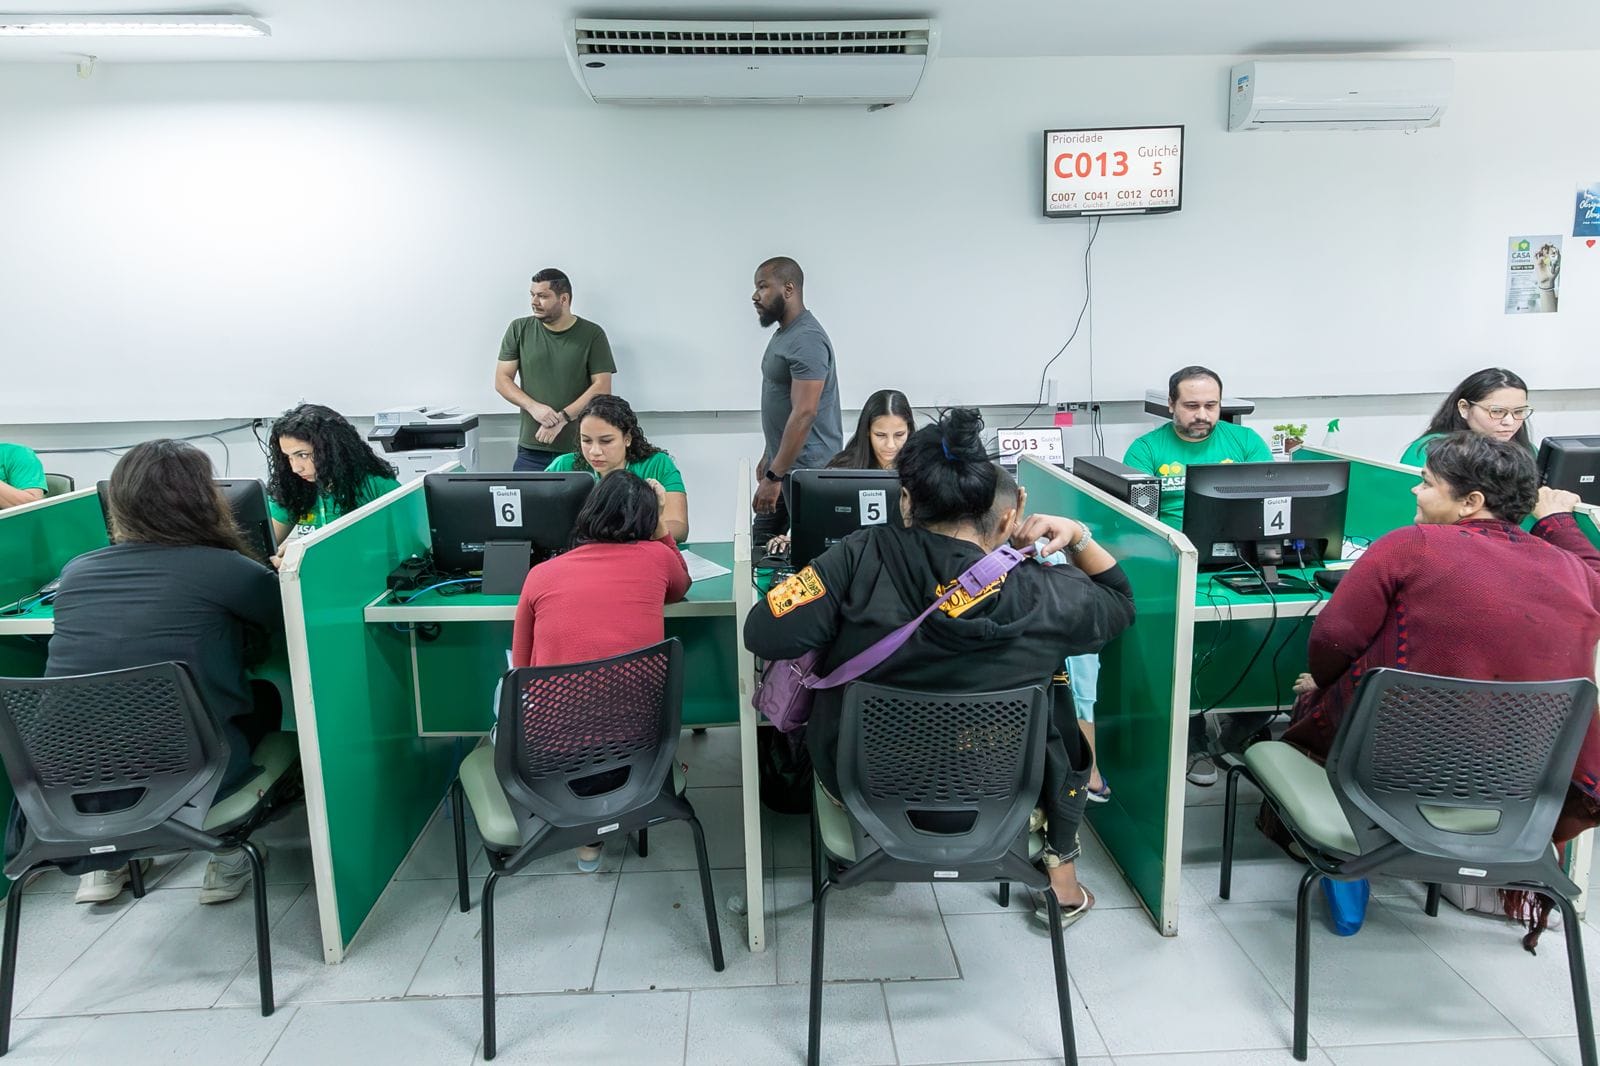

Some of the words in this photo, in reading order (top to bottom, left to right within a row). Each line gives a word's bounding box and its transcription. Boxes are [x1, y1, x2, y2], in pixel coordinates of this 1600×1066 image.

[1052, 133, 1103, 144] Prioridade
[1054, 151, 1129, 179] C013
[1152, 161, 1163, 176] 5
[1051, 192, 1076, 202] C007
[1084, 191, 1108, 201] C041
[1117, 190, 1142, 199] C012
[1150, 189, 1174, 198] C011
[1002, 439, 1038, 451] C013
[1049, 443, 1054, 451] 5
[1161, 477, 1185, 486] CASA
[501, 503, 515, 523] 6
[867, 502, 880, 521] 5
[1270, 510, 1284, 530] 4
